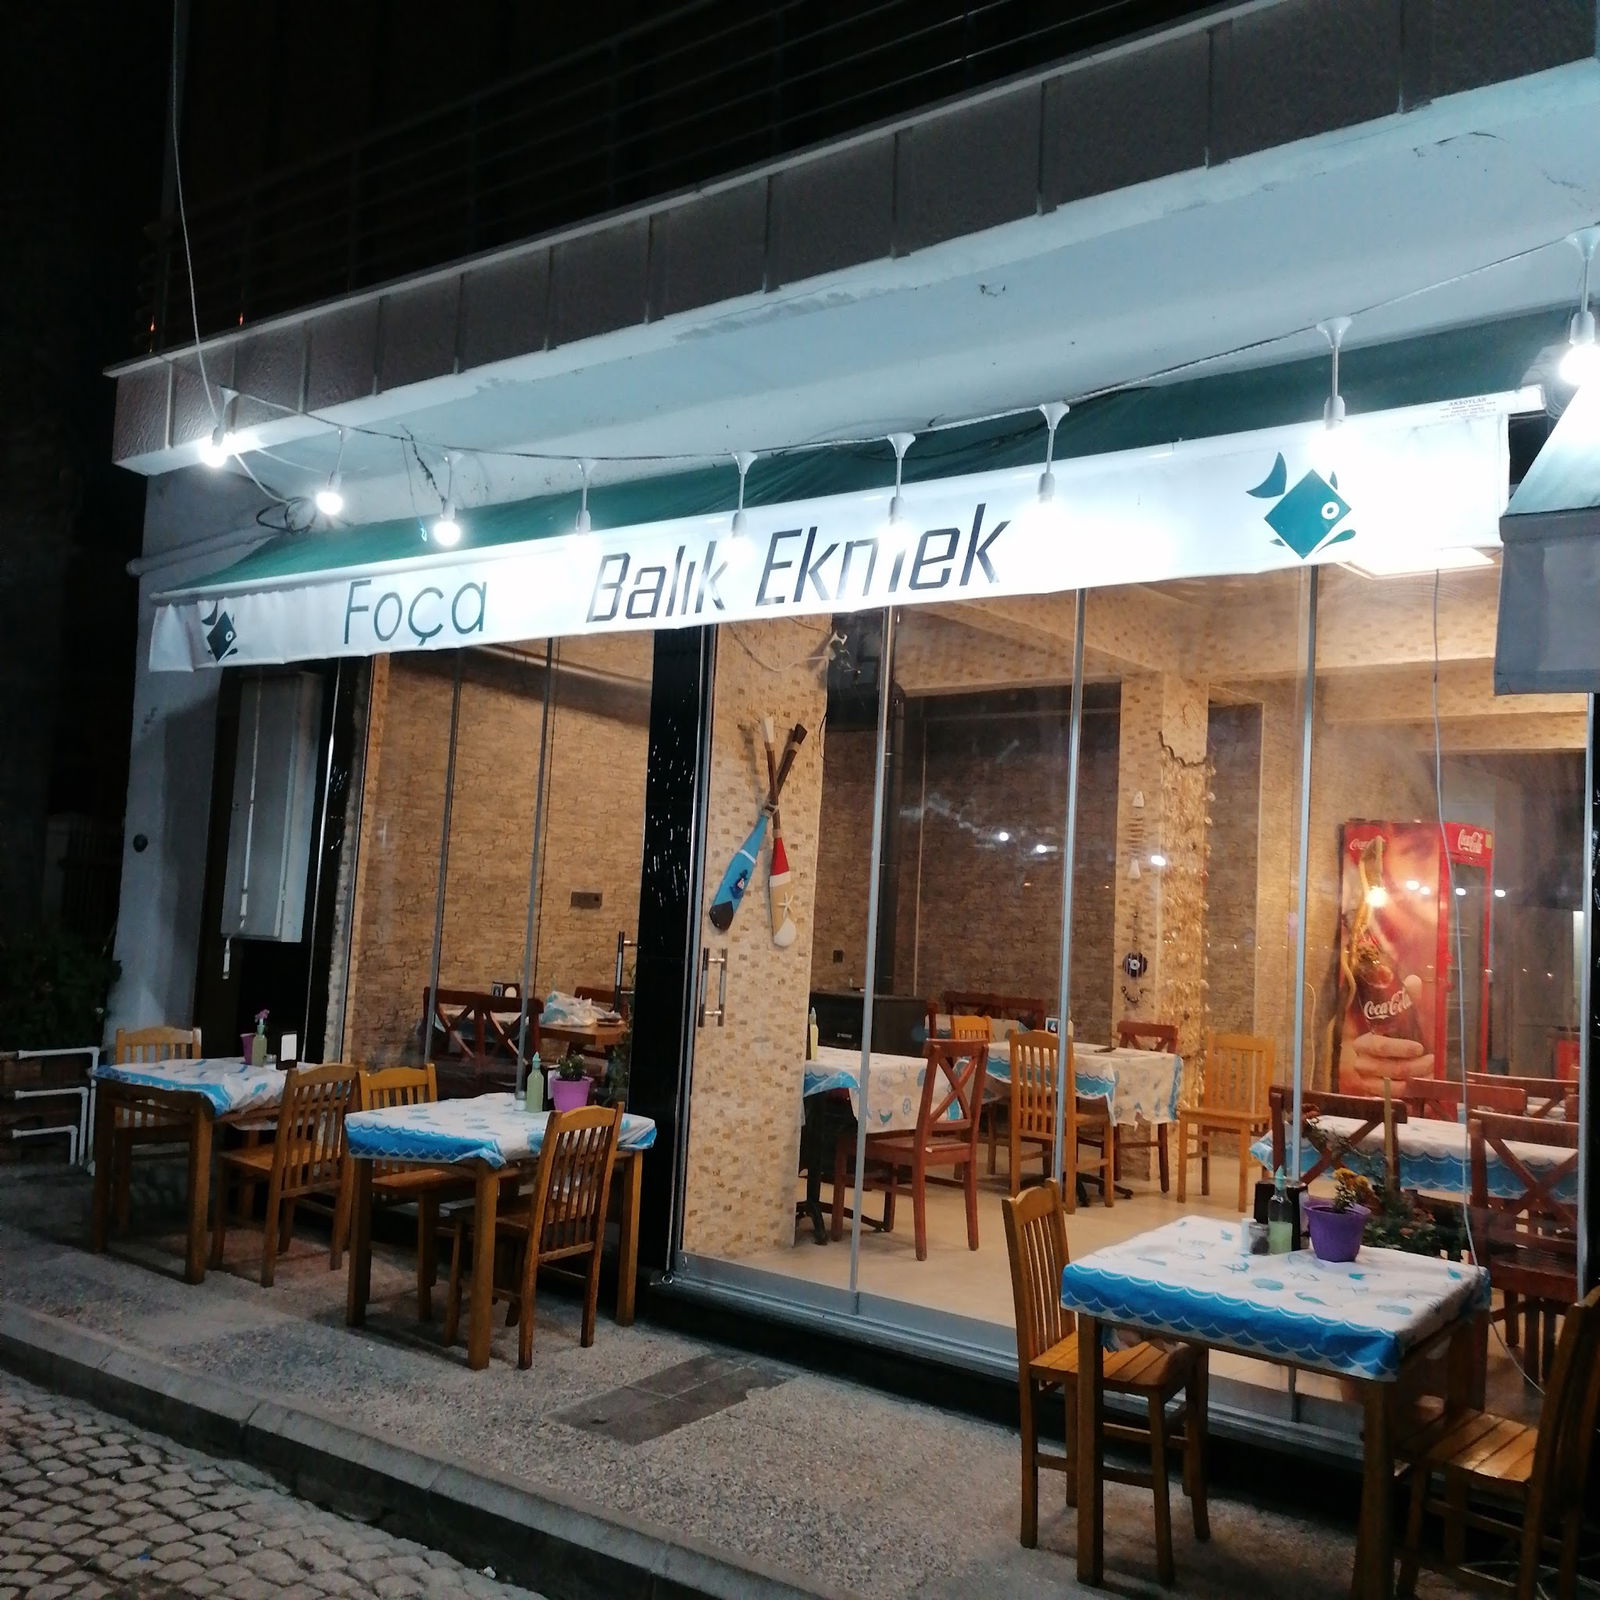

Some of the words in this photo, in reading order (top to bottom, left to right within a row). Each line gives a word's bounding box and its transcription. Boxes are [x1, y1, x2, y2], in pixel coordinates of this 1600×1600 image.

[344, 579, 487, 646] Foça
[586, 540, 728, 623] Balık
[755, 503, 1011, 606] Ekmek
